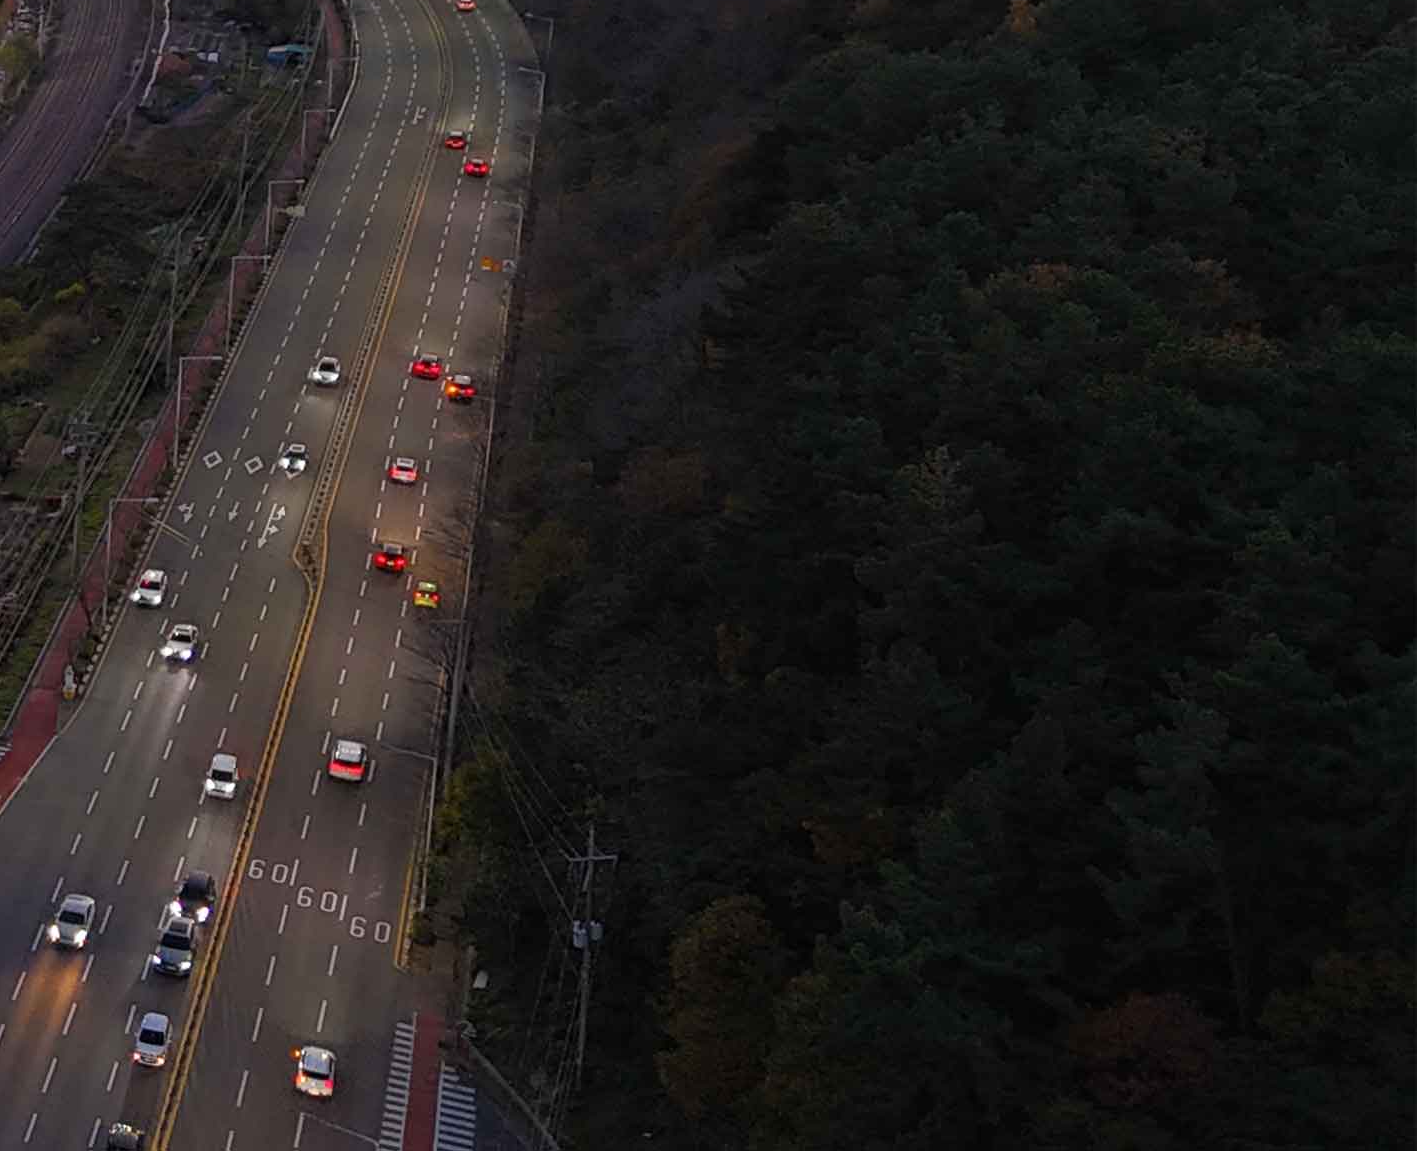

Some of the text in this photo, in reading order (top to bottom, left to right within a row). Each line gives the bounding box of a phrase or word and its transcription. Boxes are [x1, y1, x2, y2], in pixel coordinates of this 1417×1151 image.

[248, 859, 290, 884] 60
[297, 886, 339, 913] 60
[349, 916, 392, 943] 60
